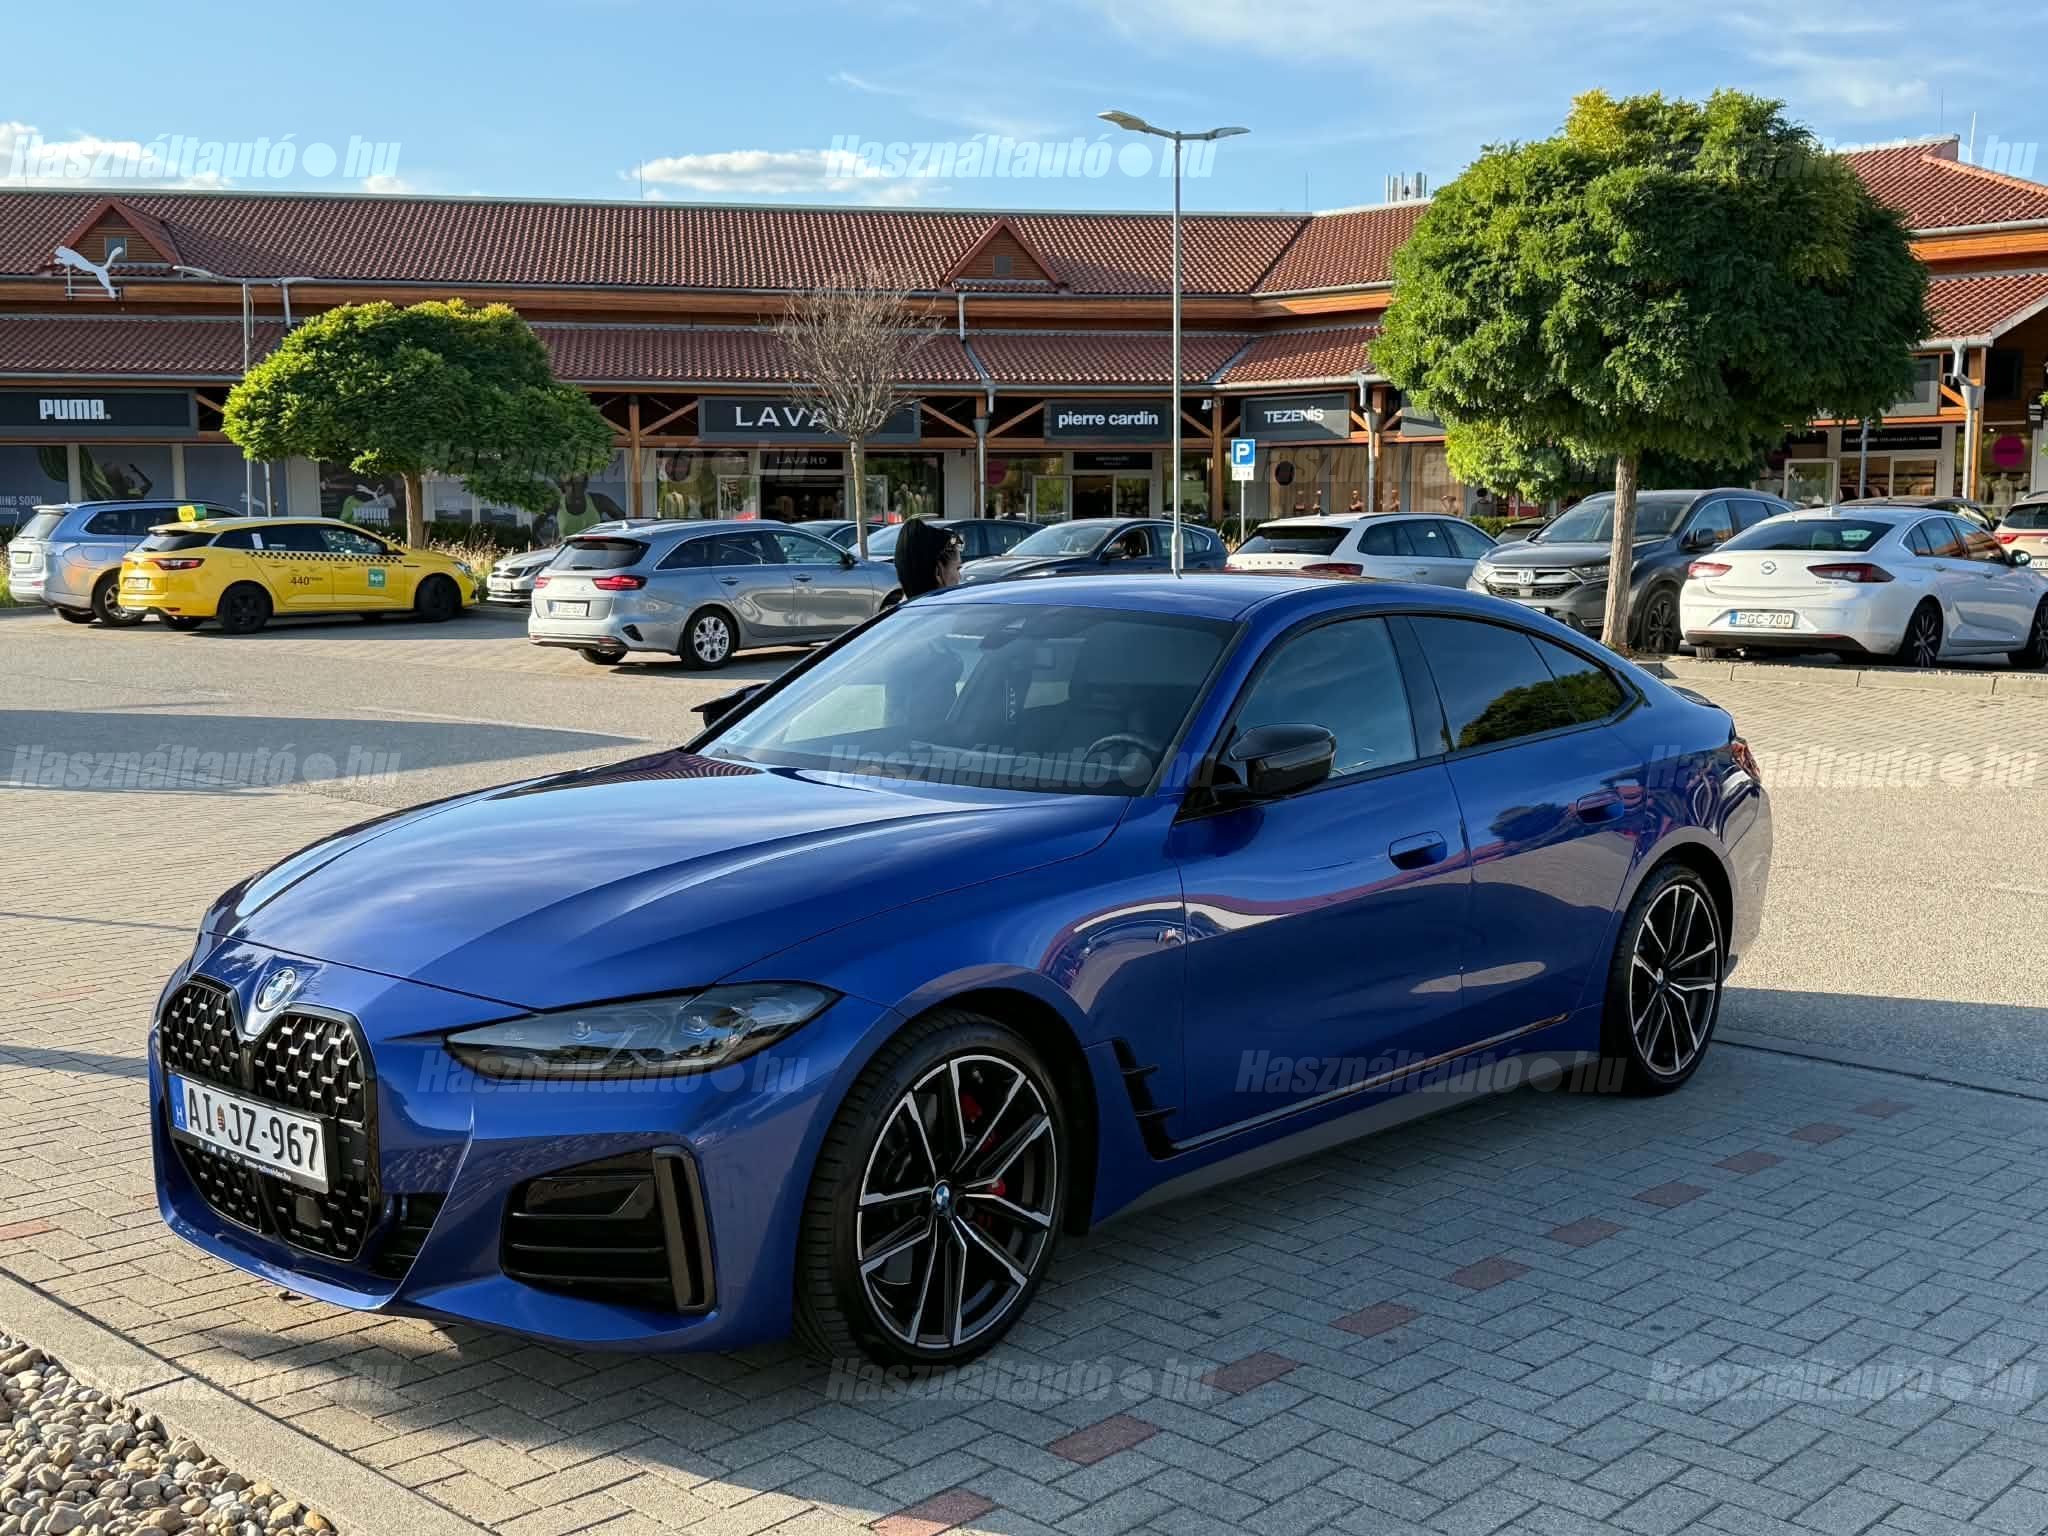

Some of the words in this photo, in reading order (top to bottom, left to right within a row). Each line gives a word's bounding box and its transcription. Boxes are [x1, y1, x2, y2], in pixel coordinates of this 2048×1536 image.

[735, 406, 874, 427] LAVA
[1058, 411, 1106, 428] pierre
[1108, 411, 1159, 425] cardin
[776, 456, 828, 465] LAVARD
[1236, 443, 1250, 464] P
